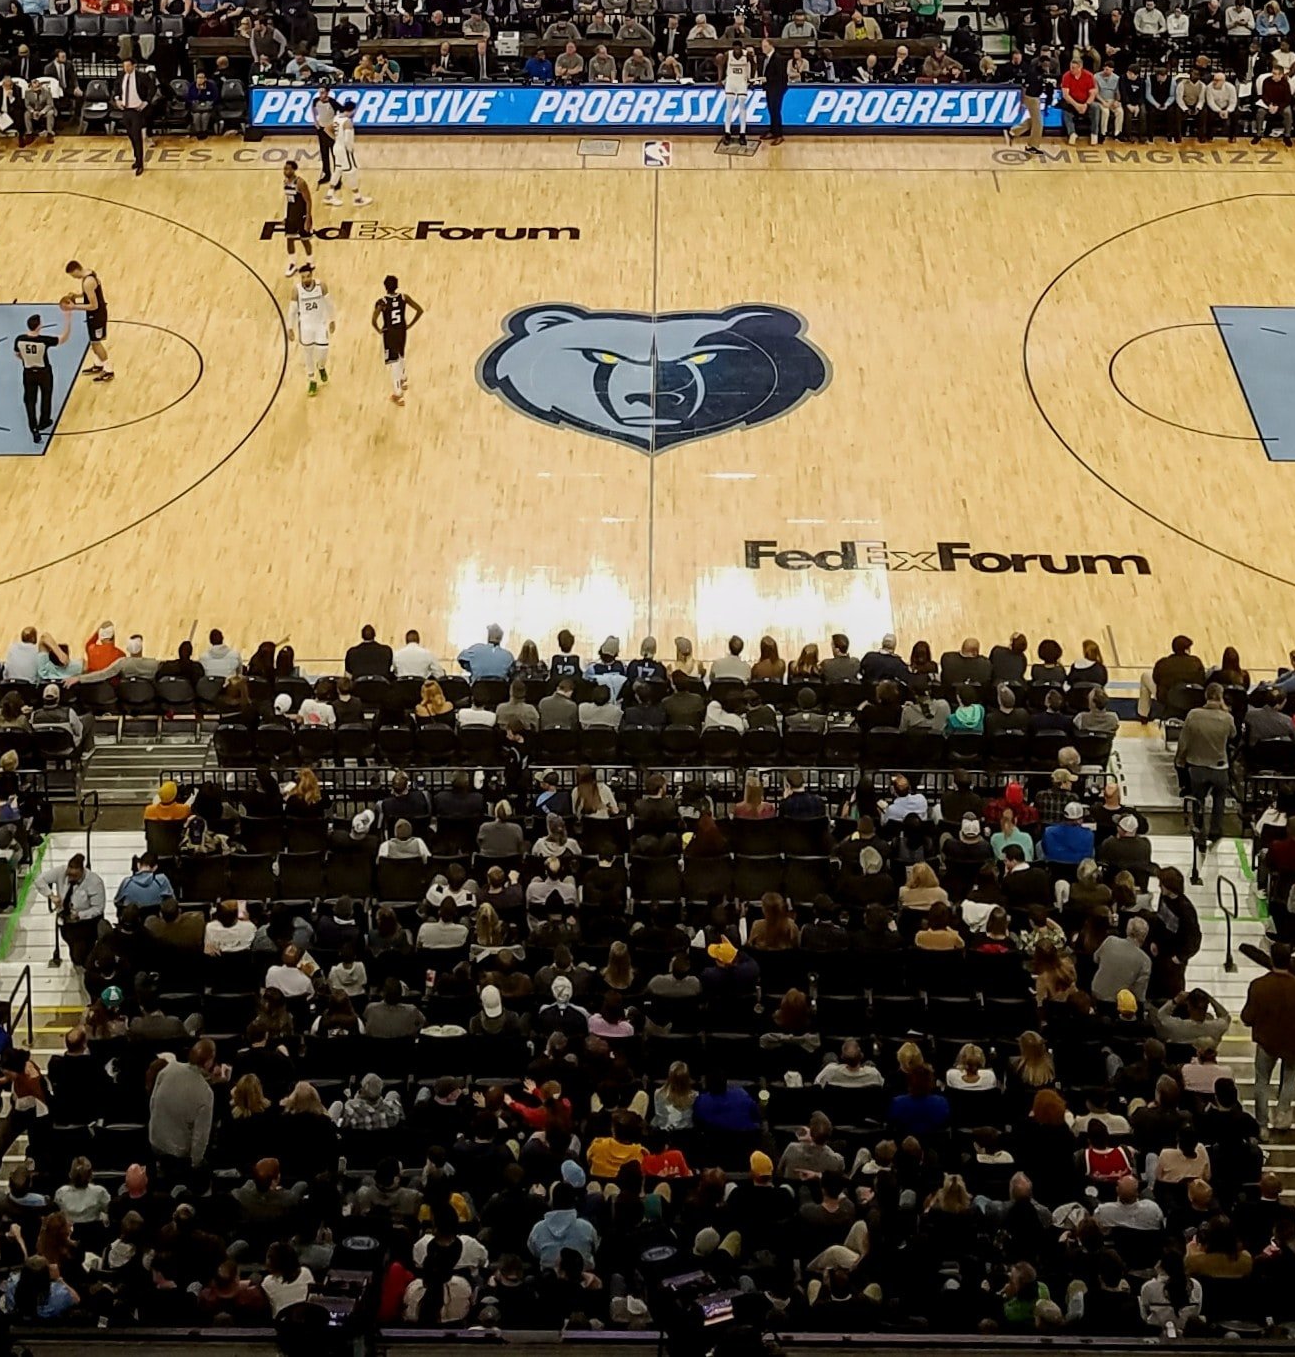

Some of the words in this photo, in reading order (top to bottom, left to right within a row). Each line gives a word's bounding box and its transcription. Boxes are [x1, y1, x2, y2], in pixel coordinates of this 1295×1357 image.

[255, 89, 497, 125] PRRESSIVE
[806, 89, 1038, 125] PROGRESSIV
[995, 148, 1284, 166] @MEMGRIZZ
[258, 220, 581, 242] FdExForum
[390, 309, 402, 325] 5
[25, 344, 38, 355] 50
[743, 539, 1153, 575] FedExForum
